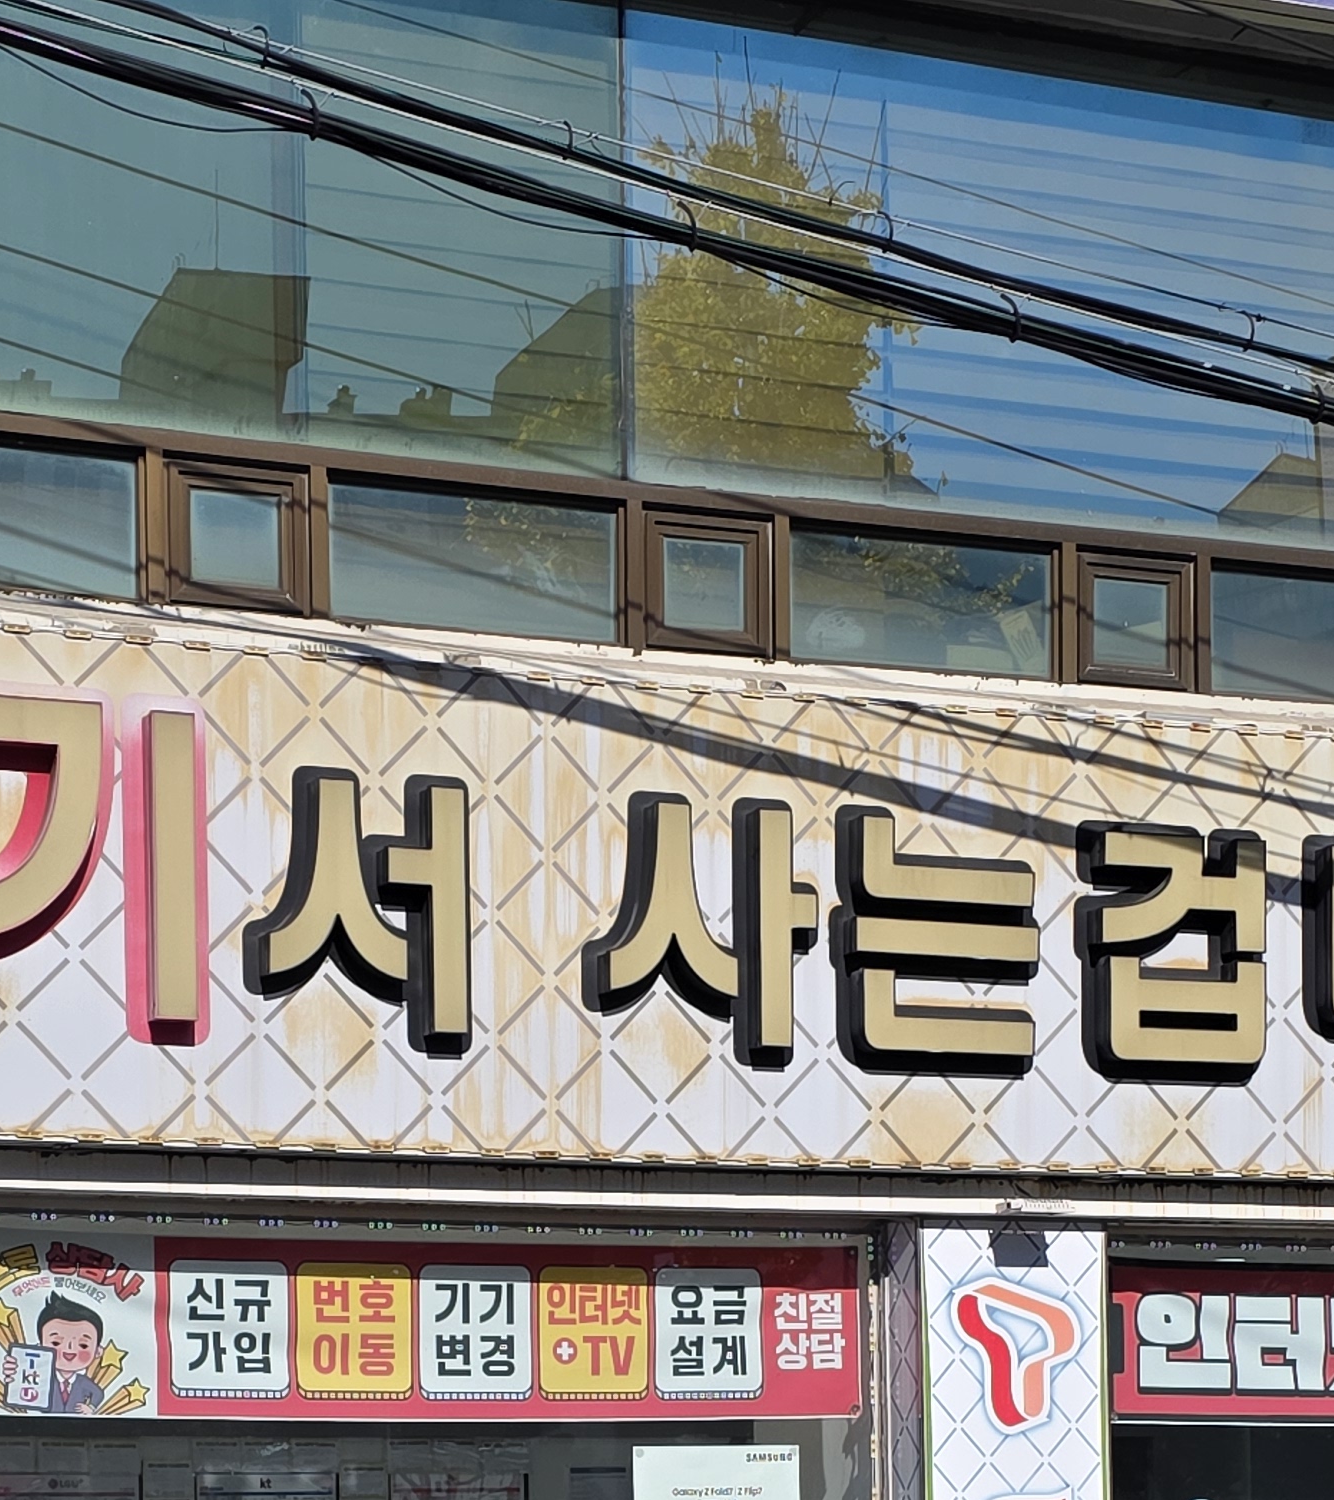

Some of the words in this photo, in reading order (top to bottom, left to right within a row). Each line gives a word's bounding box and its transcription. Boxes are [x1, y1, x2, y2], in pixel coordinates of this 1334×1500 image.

[46, 1241, 145, 1301] 상담사
[186, 1278, 272, 1322] 신규
[313, 1277, 396, 1324] 번호
[435, 1282, 515, 1325] 기기
[546, 1282, 642, 1326] 인터넷
[670, 1285, 747, 1326] 요금
[774, 1292, 843, 1330] 친절
[186, 1331, 272, 1374] 가입
[313, 1333, 395, 1376] 이동
[435, 1335, 515, 1377] 변경
[670, 1336, 747, 1377] 설계
[774, 1333, 845, 1370] 상담
[746, 1453, 793, 1462] SAMSUNG
